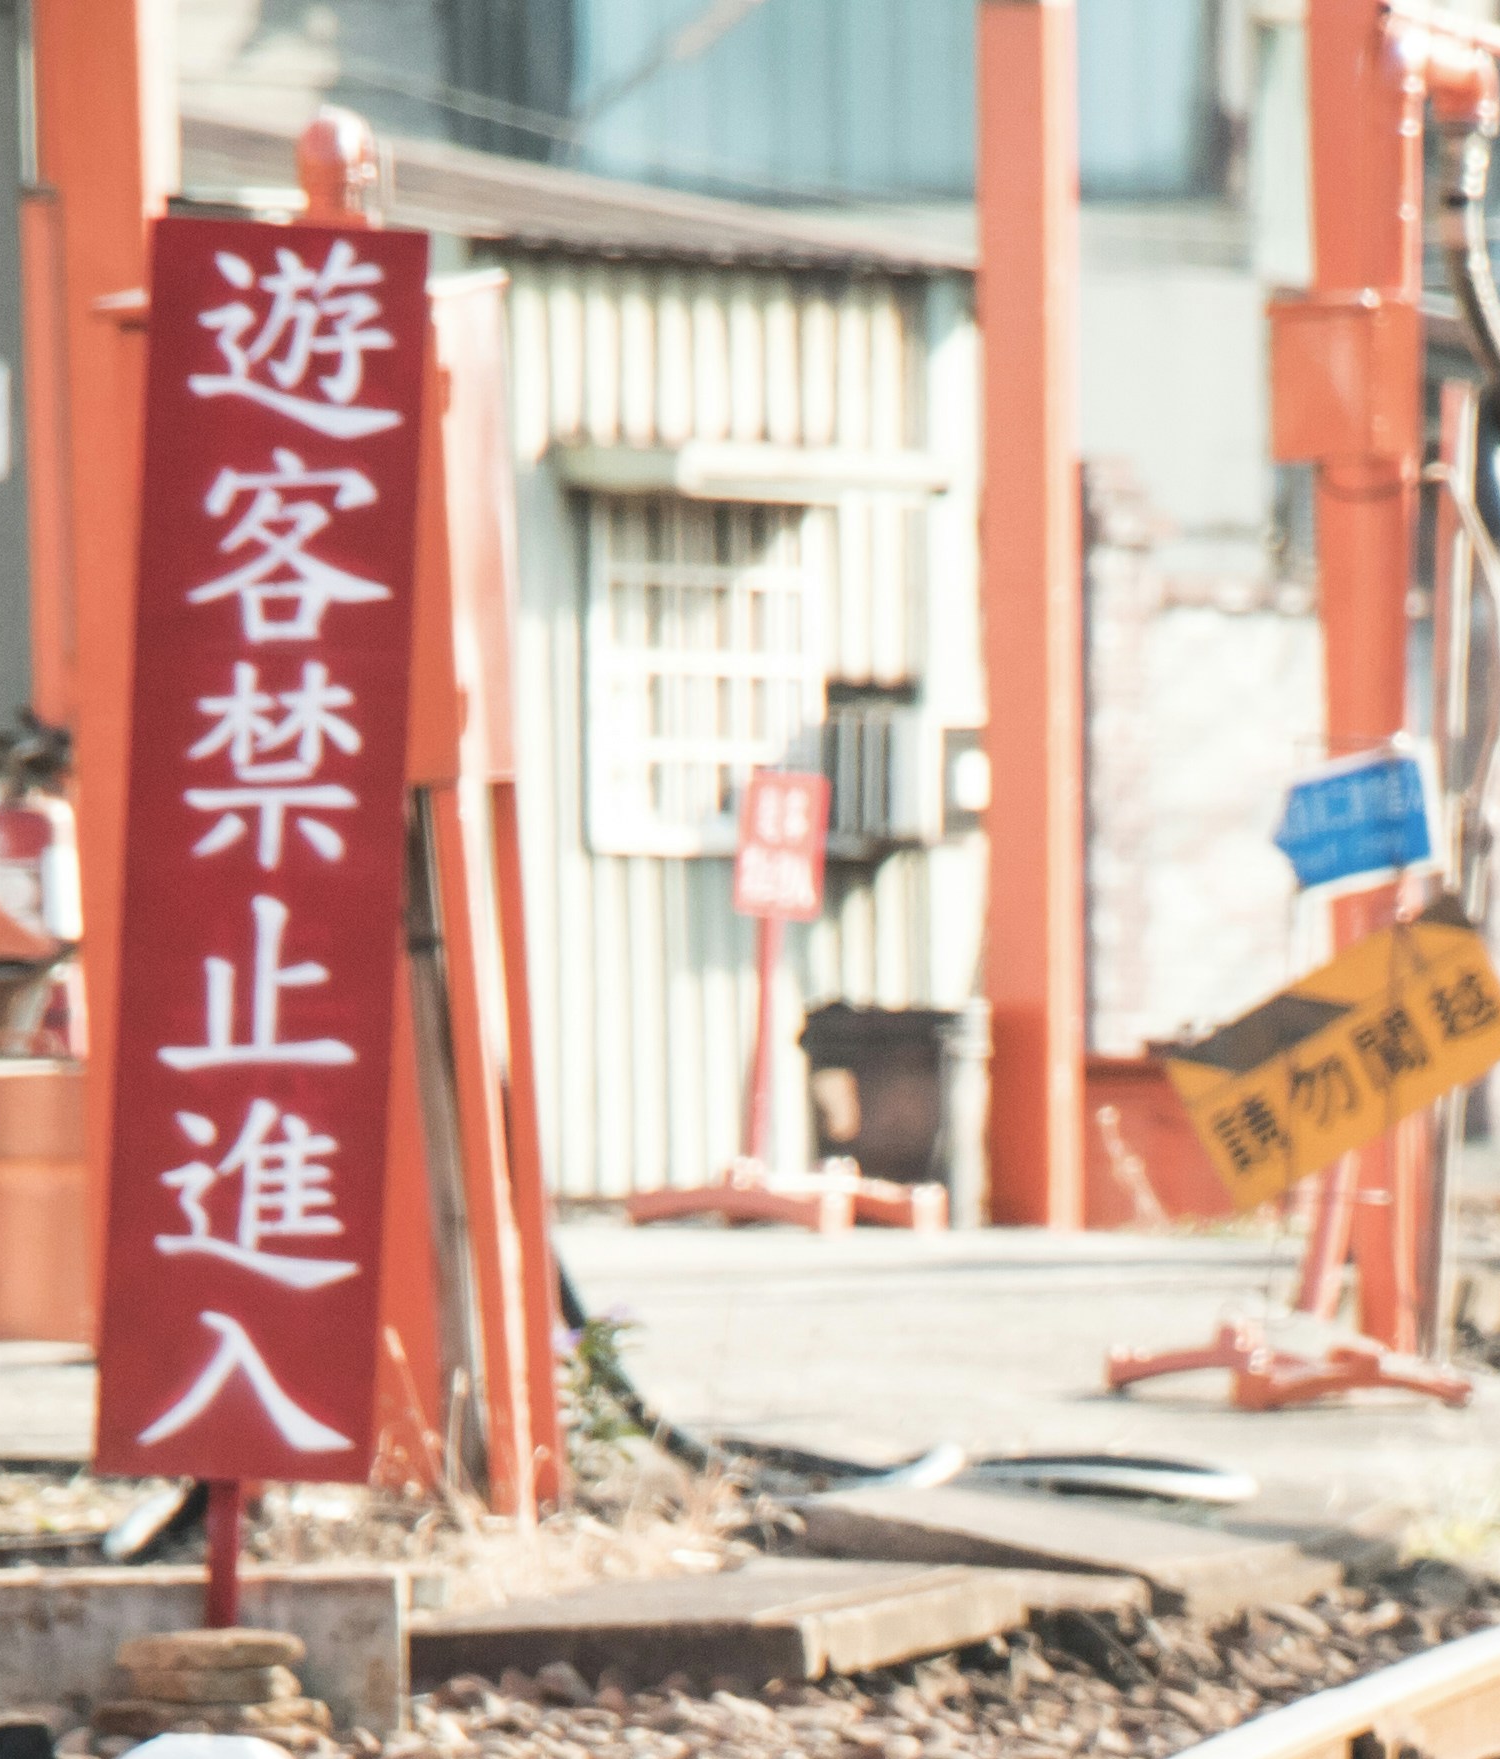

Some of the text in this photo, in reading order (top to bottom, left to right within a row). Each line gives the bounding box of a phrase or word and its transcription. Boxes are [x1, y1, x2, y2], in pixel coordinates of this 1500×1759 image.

[139, 241, 402, 1453] 遊客禁止進入
